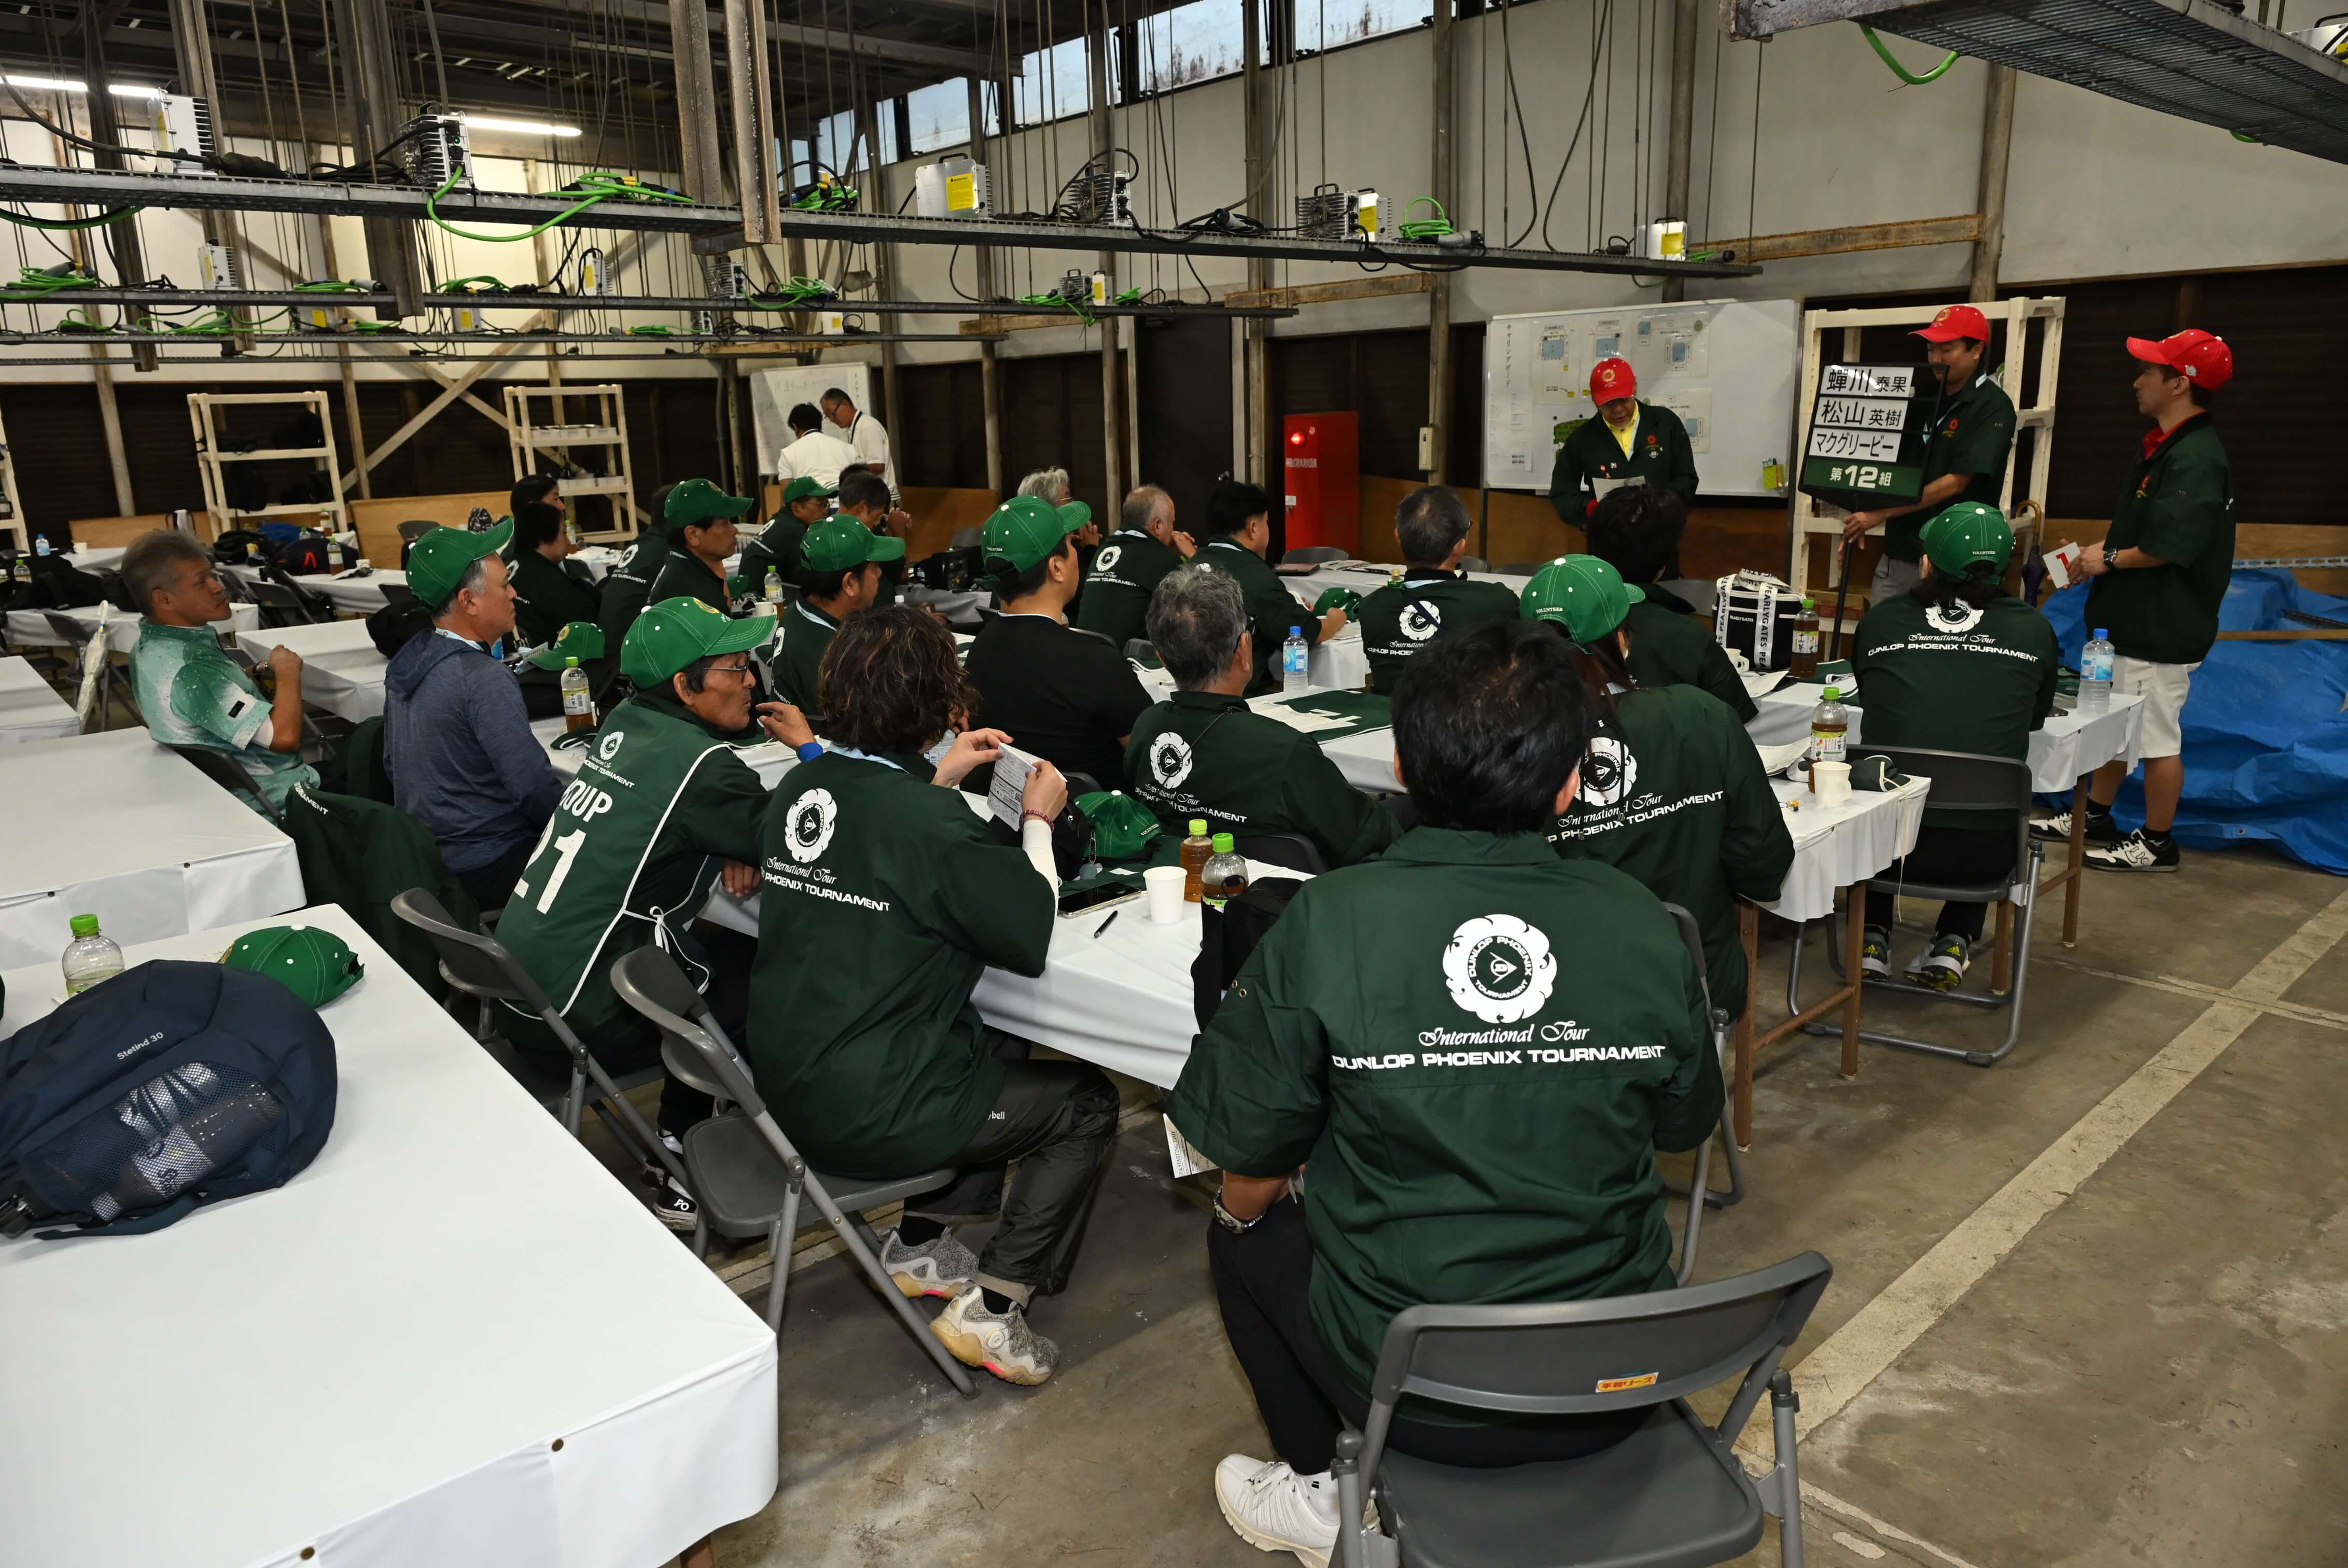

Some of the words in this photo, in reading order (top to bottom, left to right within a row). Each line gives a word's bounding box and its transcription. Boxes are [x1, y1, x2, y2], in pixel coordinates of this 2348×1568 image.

[1821, 400, 1865, 425] 松山
[1868, 409, 1902, 427] 英樹
[1816, 431, 1894, 457] マクグリービー
[1908, 633, 1967, 642] International
[1970, 634, 1996, 644] Tour
[1868, 643, 1905, 656] DUNLOP
[1962, 644, 2038, 663] TOURNAMENT
[1177, 793, 1200, 806] Tour
[1626, 790, 1724, 825] TOURNAMENT
[1632, 793, 1664, 809] Tour
[795, 804, 814, 828] DUNLOP
[815, 804, 824, 833] PHOENIX
[767, 857, 813, 878] International
[813, 868, 837, 885] Tour
[765, 872, 803, 891] PHOENIX
[805, 884, 890, 911] TOURNAMENT
[1469, 937, 1493, 978] DUNLOP
[1497, 936, 1532, 976] PHOENIX
[1475, 979, 1528, 999] TOURNAMENT
[117, 1038, 150, 1060] Stetind
[150, 1032, 163, 1042] 30
[1418, 1023, 1534, 1047] International
[1541, 1020, 1590, 1043] Tour
[1332, 1053, 1415, 1070] DUNLOP
[1422, 1050, 1522, 1067] PHOENIX
[1528, 1045, 1666, 1063] TOURNAMENT
[1173, 1143, 1182, 1168] STARTING
